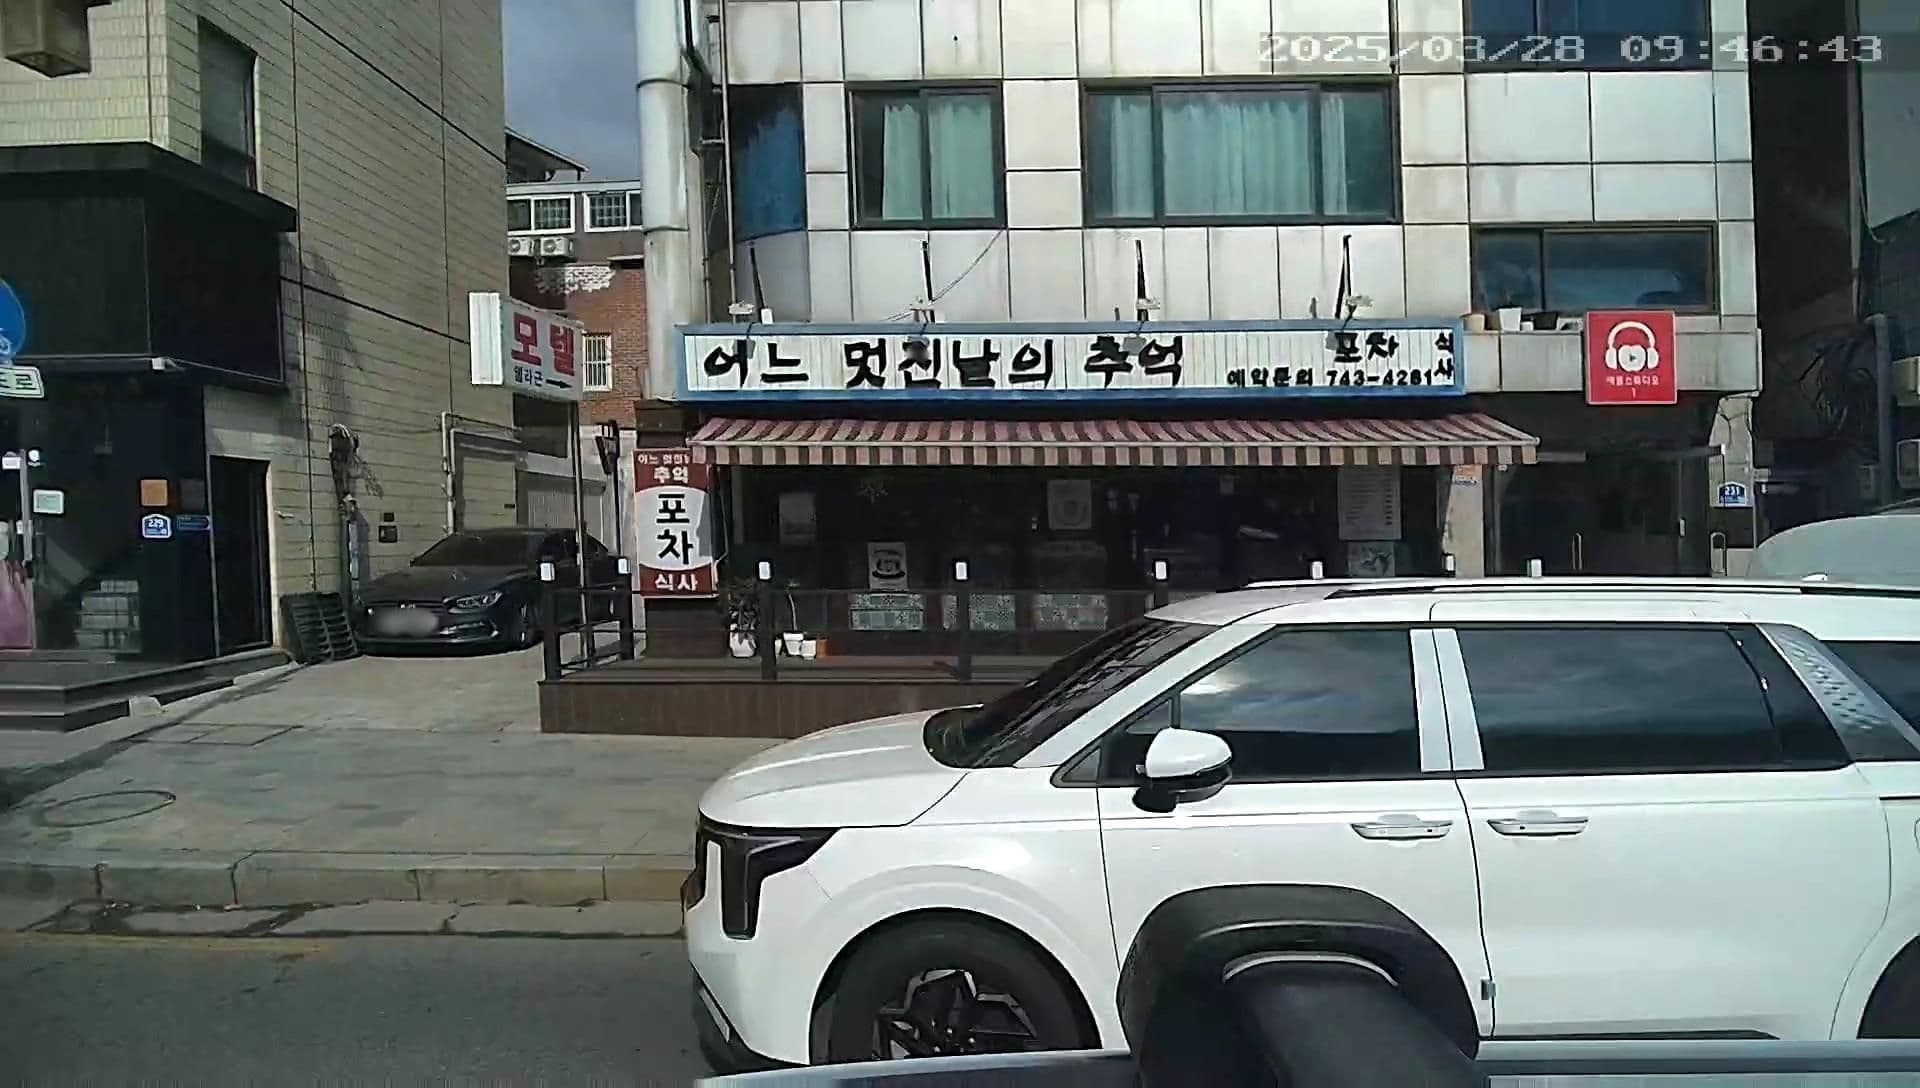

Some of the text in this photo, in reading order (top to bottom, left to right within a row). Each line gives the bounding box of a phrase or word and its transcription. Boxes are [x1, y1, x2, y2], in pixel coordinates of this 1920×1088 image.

[511, 312, 576, 377] 모텔
[1333, 331, 1400, 363] 포차
[703, 335, 1183, 389] 어느 멋진날의 추억
[1227, 366, 1433, 387] 예약문의 743-4281
[653, 466, 690, 484] 추억
[1724, 486, 1740, 496] 231
[148, 518, 164, 528] 229
[656, 493, 694, 565] 포차
[654, 573, 698, 592] 식사
